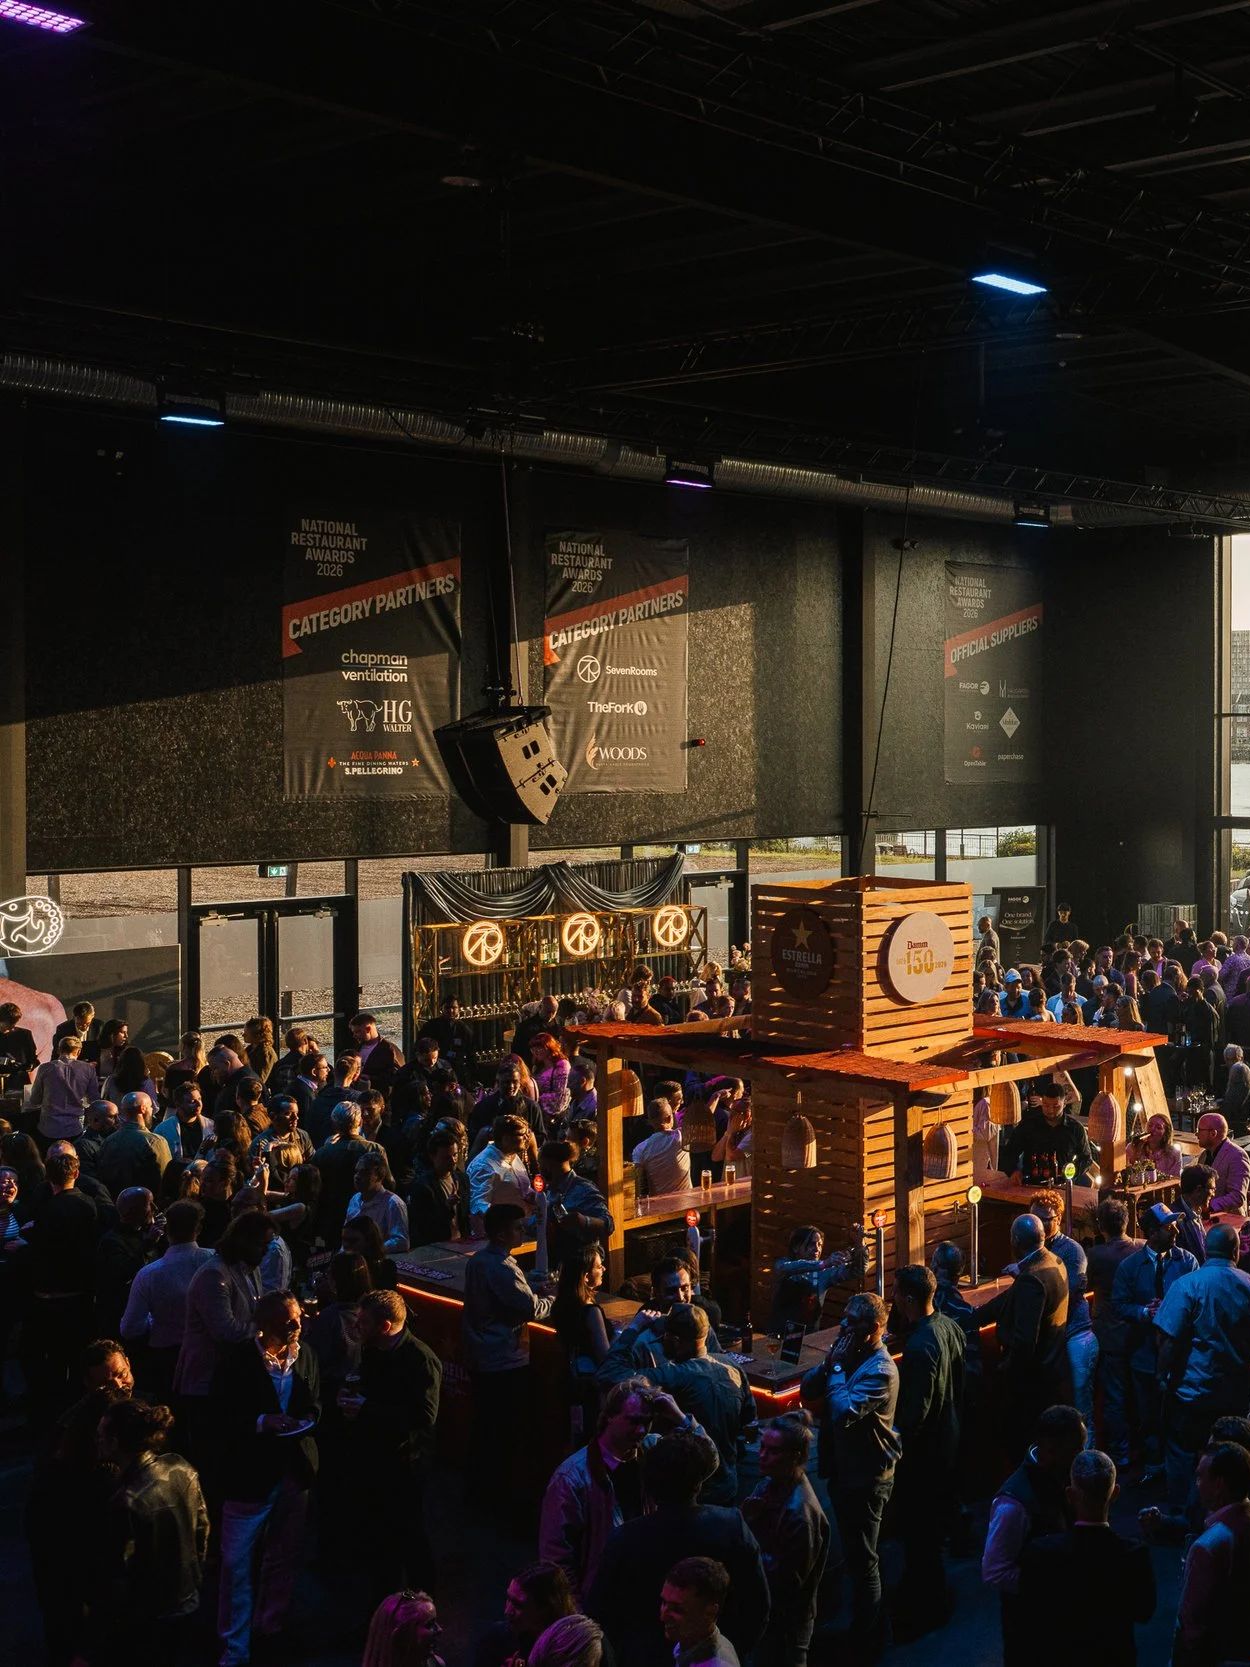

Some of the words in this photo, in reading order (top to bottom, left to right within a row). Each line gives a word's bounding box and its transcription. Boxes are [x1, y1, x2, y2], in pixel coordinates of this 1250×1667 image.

[301, 518, 358, 536] NATIONAL
[291, 532, 368, 551] RESTAURANT
[560, 541, 605, 556] NATIONAL
[305, 547, 355, 564] AWARDS
[551, 553, 613, 570] RESTAURANT
[317, 562, 343, 577] 2026
[562, 567, 602, 582] AWARDS
[572, 580, 593, 593] 2026
[955, 576, 986, 588] NATIONAL
[949, 586, 991, 599] RESTAURANT
[289, 598, 374, 640] CATEGORY
[375, 573, 455, 614] PARTNERS
[957, 597, 984, 608] AWARDS
[549, 611, 617, 650] CATEGORY
[618, 589, 684, 626] PARTNERS
[950, 636, 989, 664] OFFICIAL
[991, 616, 1039, 648] SUPPLIERS
[341, 649, 408, 668] chapman
[342, 669, 408, 682] ventilation
[605, 665, 658, 677] SevenRooms
[383, 700, 412, 724] HG
[587, 701, 634, 714] TheFork
[383, 724, 412, 733] WALTER
[599, 746, 647, 760] WOODS
[344, 767, 403, 775] S.PELLEGRINO
[781, 948, 823, 965] ESTRELLA
[906, 949, 935, 976] 150
